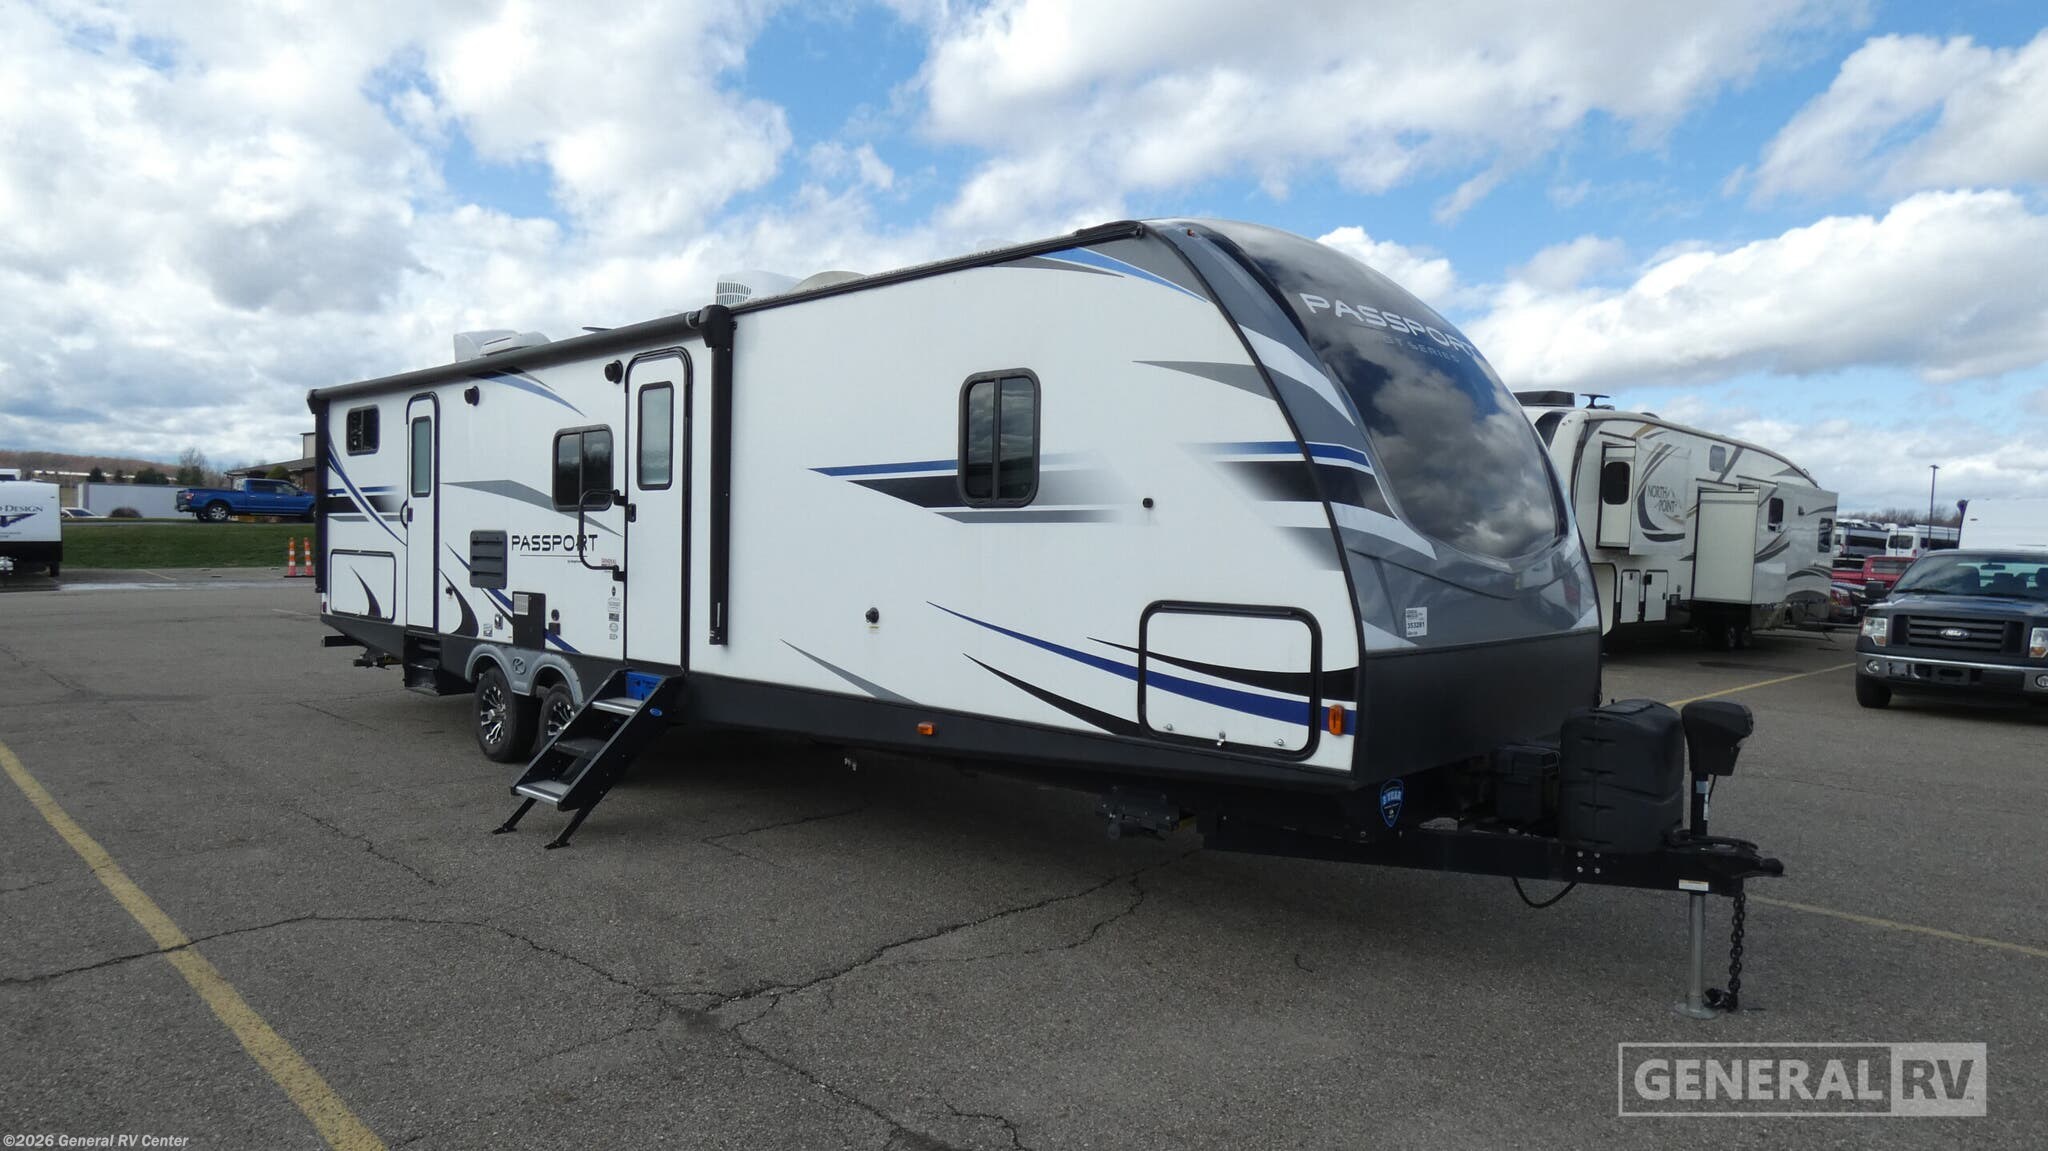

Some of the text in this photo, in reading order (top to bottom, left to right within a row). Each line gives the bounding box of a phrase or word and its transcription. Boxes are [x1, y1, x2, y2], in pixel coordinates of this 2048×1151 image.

[1299, 293, 1475, 356] PASSPORT
[1647, 485, 1670, 498] NORTH
[1658, 499, 1675, 512] POINT
[511, 535, 598, 551] PASSPORT
